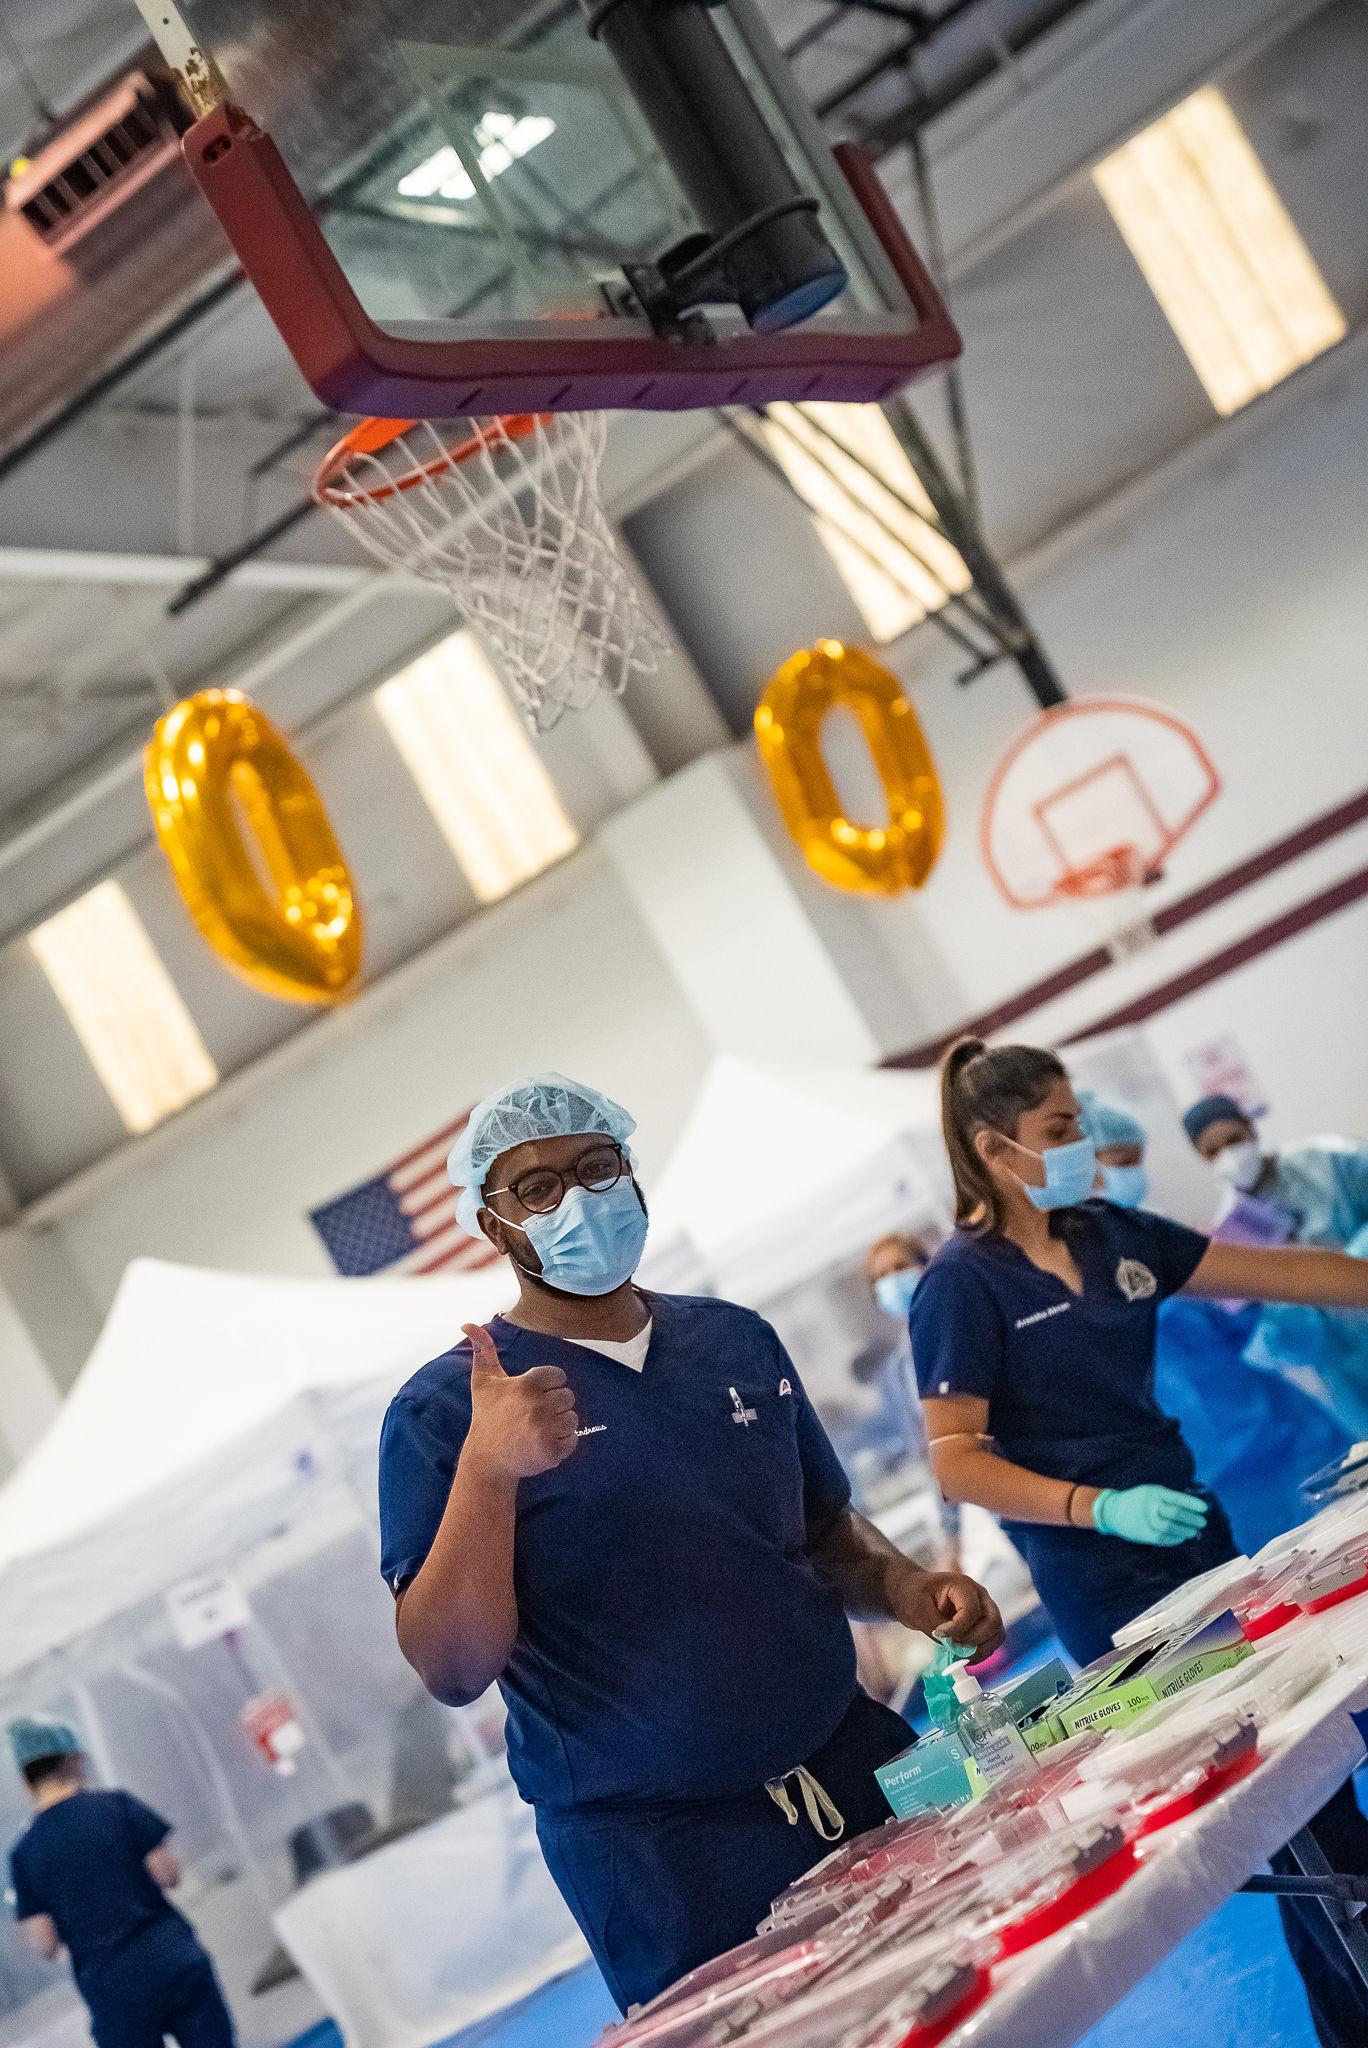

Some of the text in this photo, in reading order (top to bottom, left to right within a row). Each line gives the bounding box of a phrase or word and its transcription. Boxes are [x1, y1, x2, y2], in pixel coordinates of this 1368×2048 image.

[1161, 1676, 1185, 1698] NITRILE
[1183, 1660, 1204, 1683] GLOVES
[1009, 1699, 1024, 1714] orm
[1074, 1712, 1098, 1730] NITRILE
[1098, 1702, 1121, 1718] GLOVES
[951, 1748, 961, 1761] S
[884, 1765, 922, 1789] Perform
